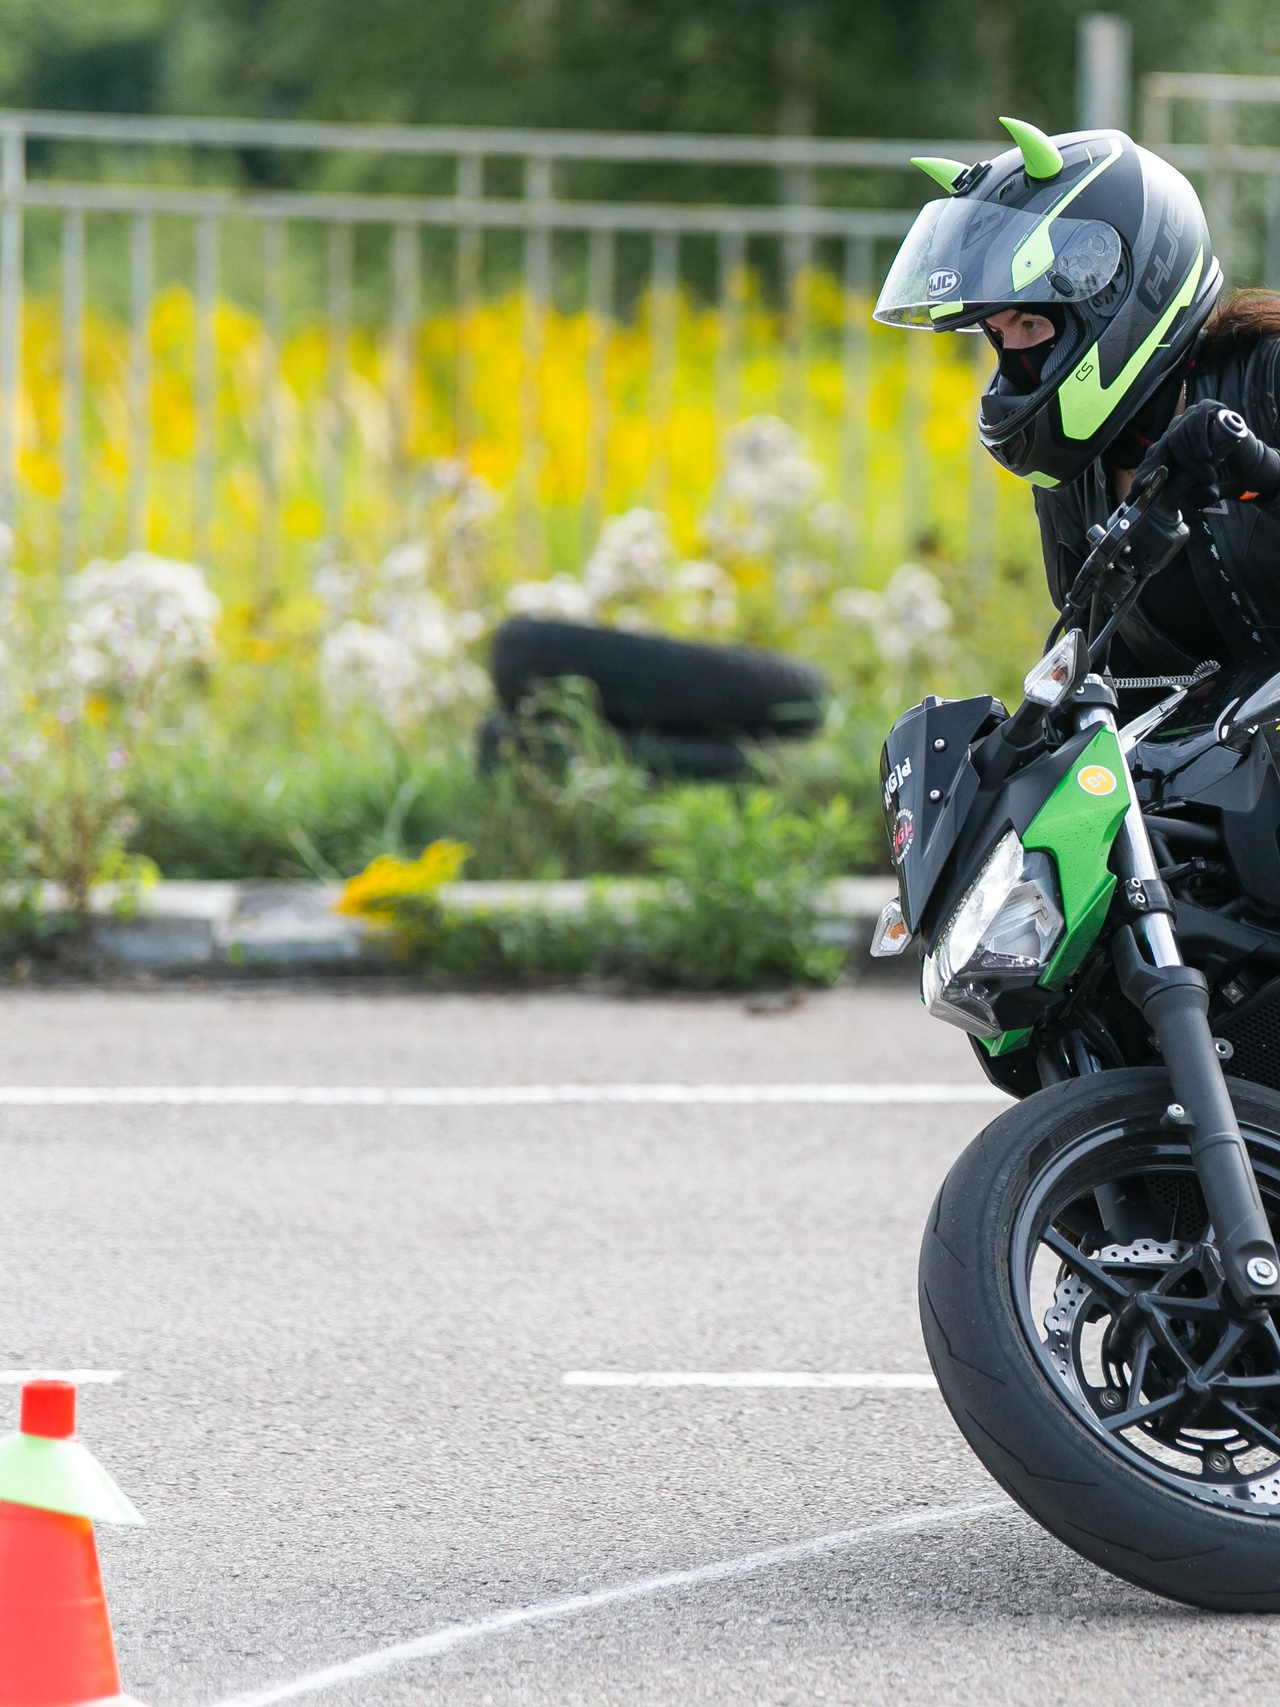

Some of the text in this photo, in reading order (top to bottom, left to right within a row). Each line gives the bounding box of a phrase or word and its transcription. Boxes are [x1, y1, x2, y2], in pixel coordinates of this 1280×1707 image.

[1144, 192, 1185, 305] HJC
[1075, 361, 1094, 382] CS
[1085, 772, 1109, 789] D1
